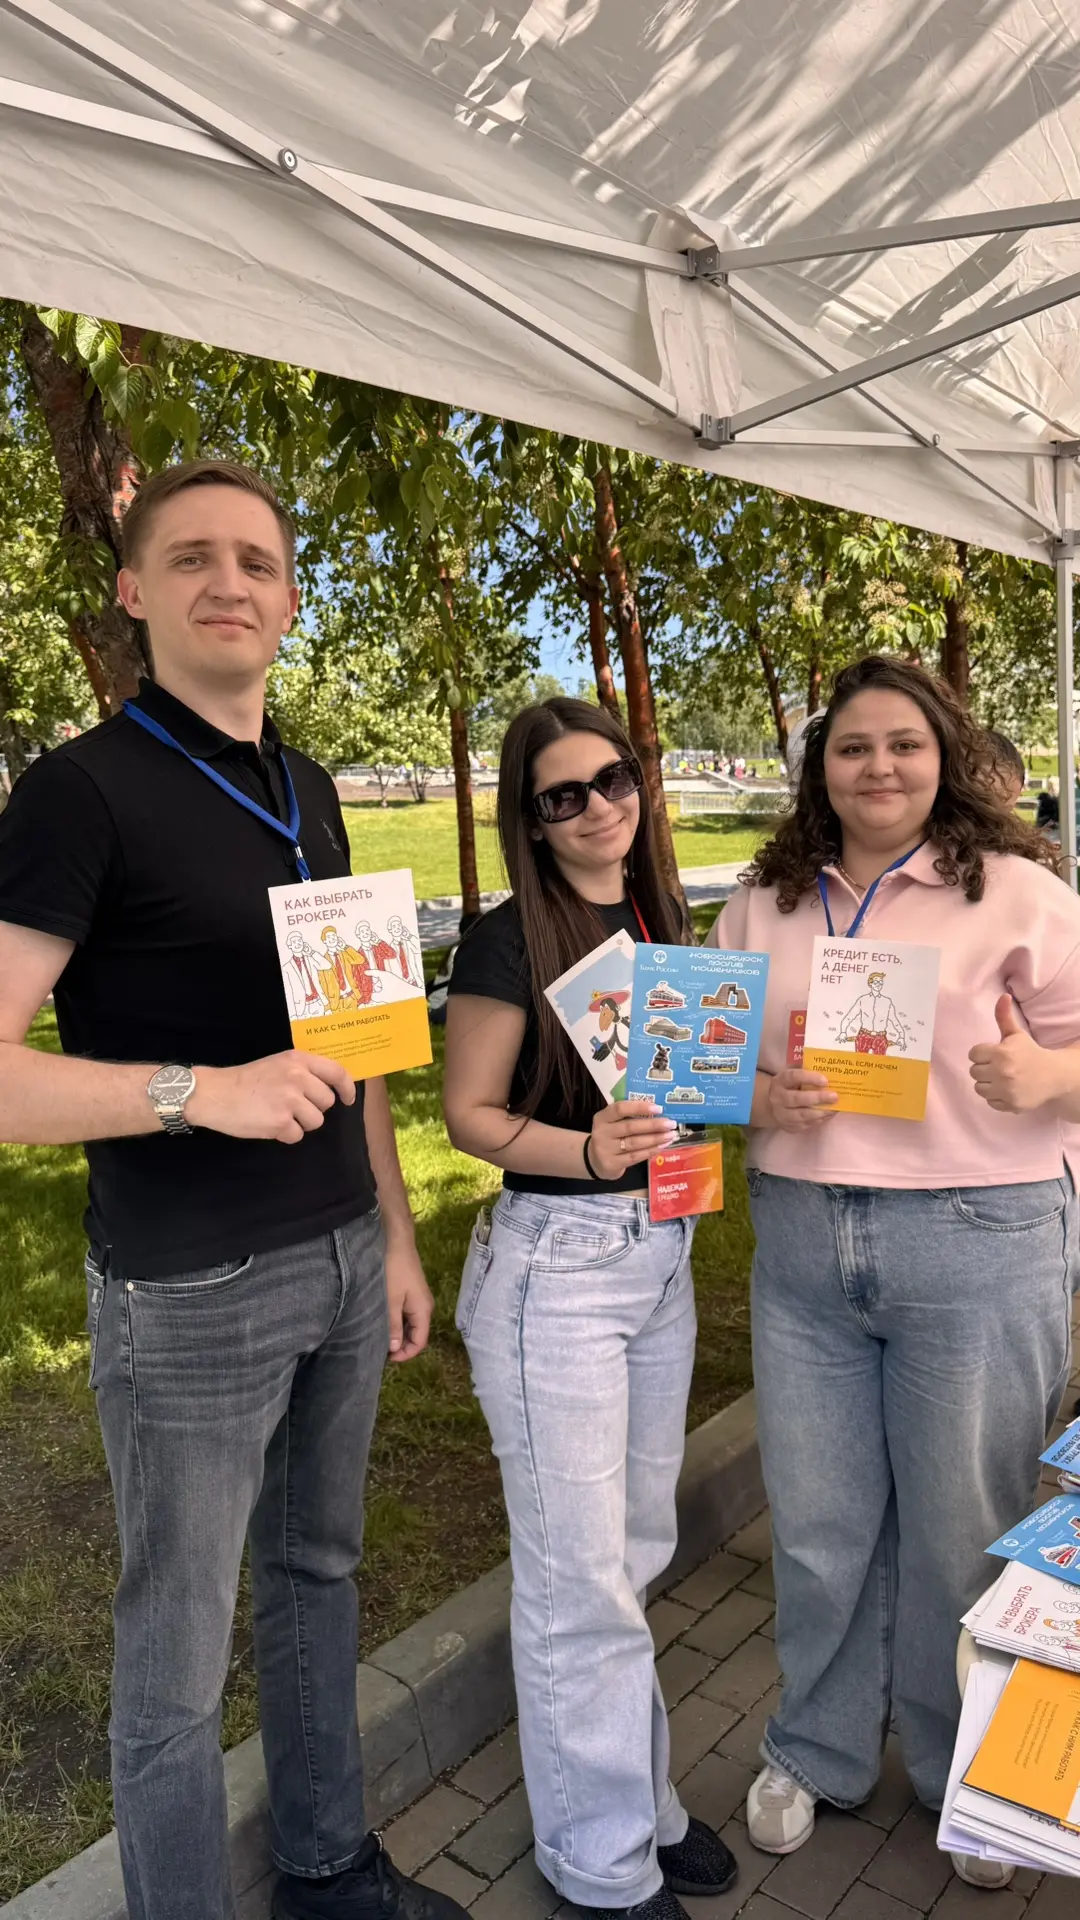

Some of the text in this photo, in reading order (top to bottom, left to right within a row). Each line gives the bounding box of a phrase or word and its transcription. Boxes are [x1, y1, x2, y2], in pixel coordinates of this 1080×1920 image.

[284, 889, 373, 911] КАК ВЫБРАТЬ
[287, 908, 346, 926] БРОКЕРА
[823, 948, 903, 965] КРЕДИТ ЕСТЬ,
[821, 961, 869, 974] А ДЕНЕГ
[820, 974, 843, 985] НЕТ
[314, 1026, 330, 1034] КАК
[338, 1021, 355, 1030] НИМ
[356, 1014, 391, 1025] РАБОТАТЬ
[812, 1065, 870, 1077] ПЛАТИТЬ ДОЛГИ?
[813, 1056, 827, 1064] ЧТО
[875, 1063, 898, 1071] НЕЧЕМ
[996, 1585, 1033, 1629] КАК ВЫБРАТЬ
[1013, 1607, 1042, 1635] БРОКЕРА
[1064, 1735, 1077, 1752] НИМ
[1054, 1751, 1072, 1781] РАБОТАТЬ
